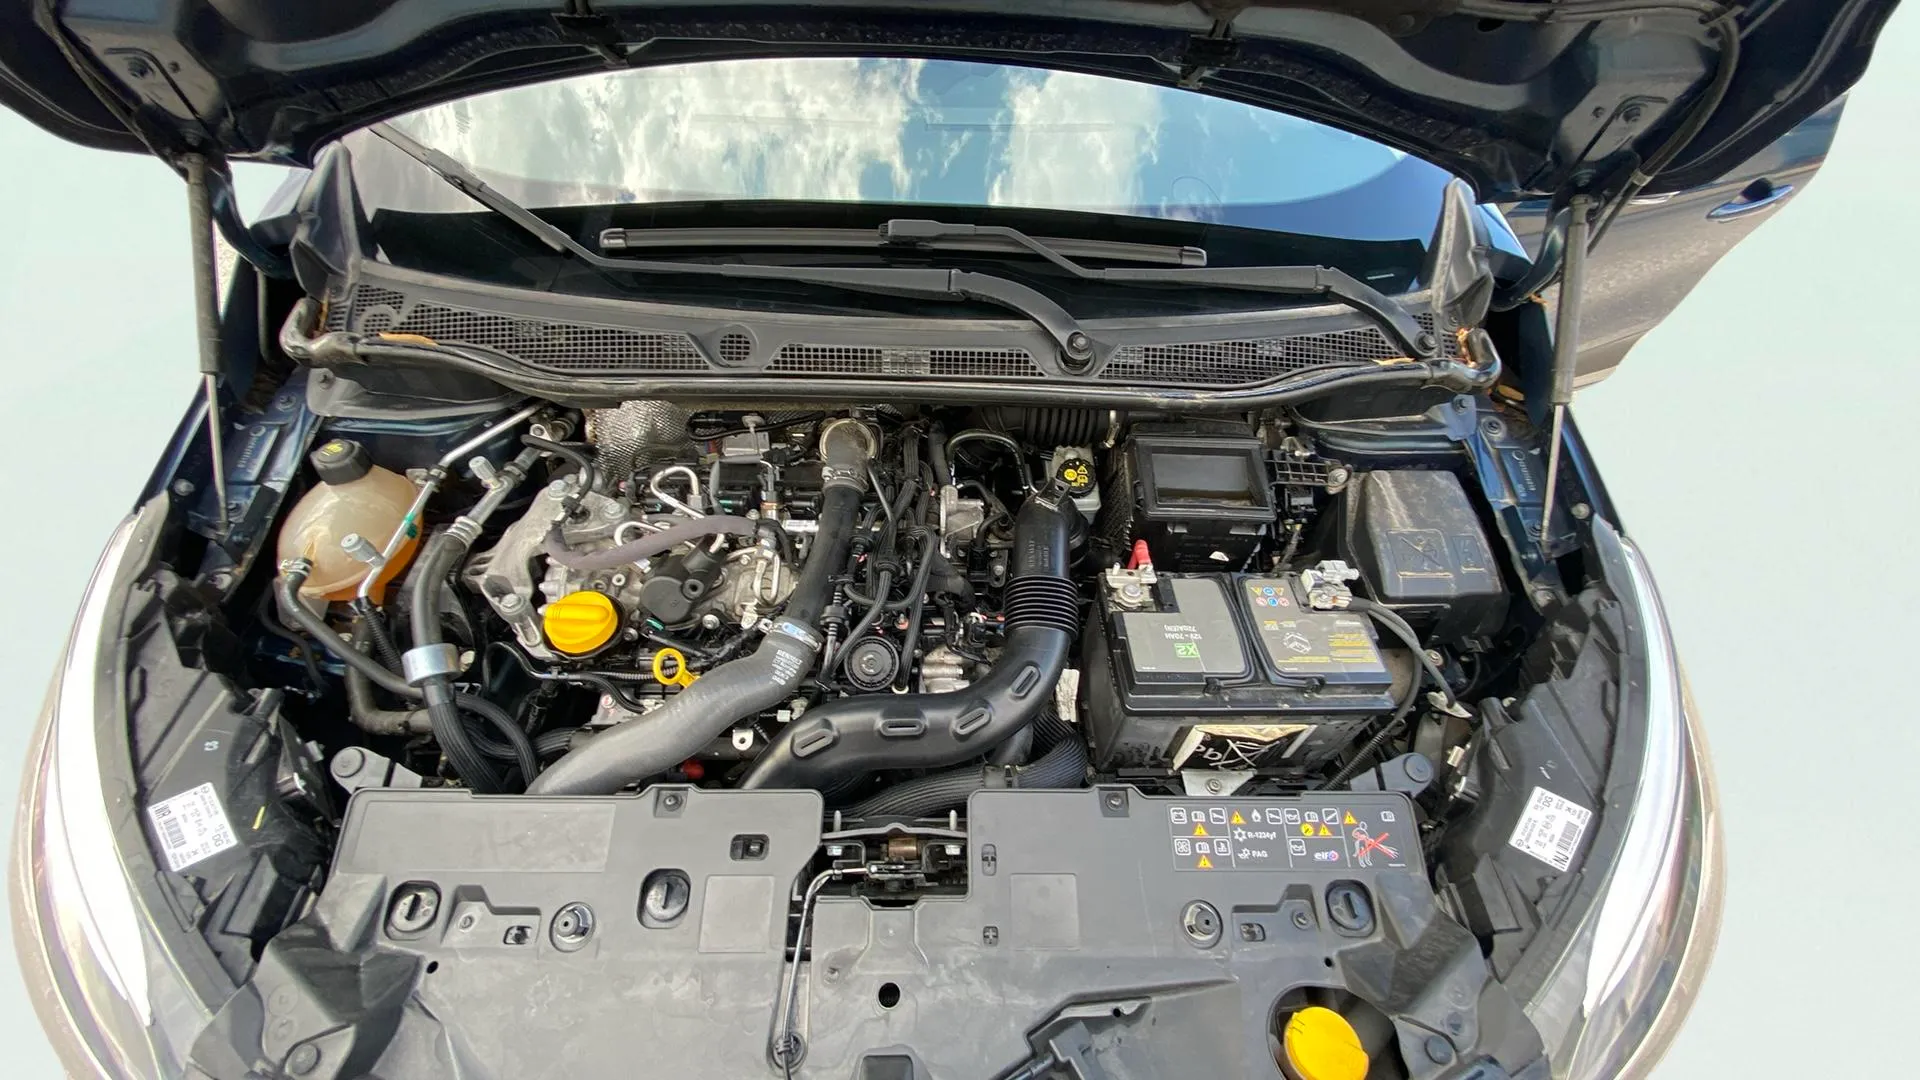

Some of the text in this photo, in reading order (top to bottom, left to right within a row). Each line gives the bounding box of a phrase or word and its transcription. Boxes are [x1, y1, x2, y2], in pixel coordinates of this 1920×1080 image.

[1175, 644, 1199, 657] X2
[1251, 850, 1269, 858] PAG
[1314, 850, 1330, 860] elf
